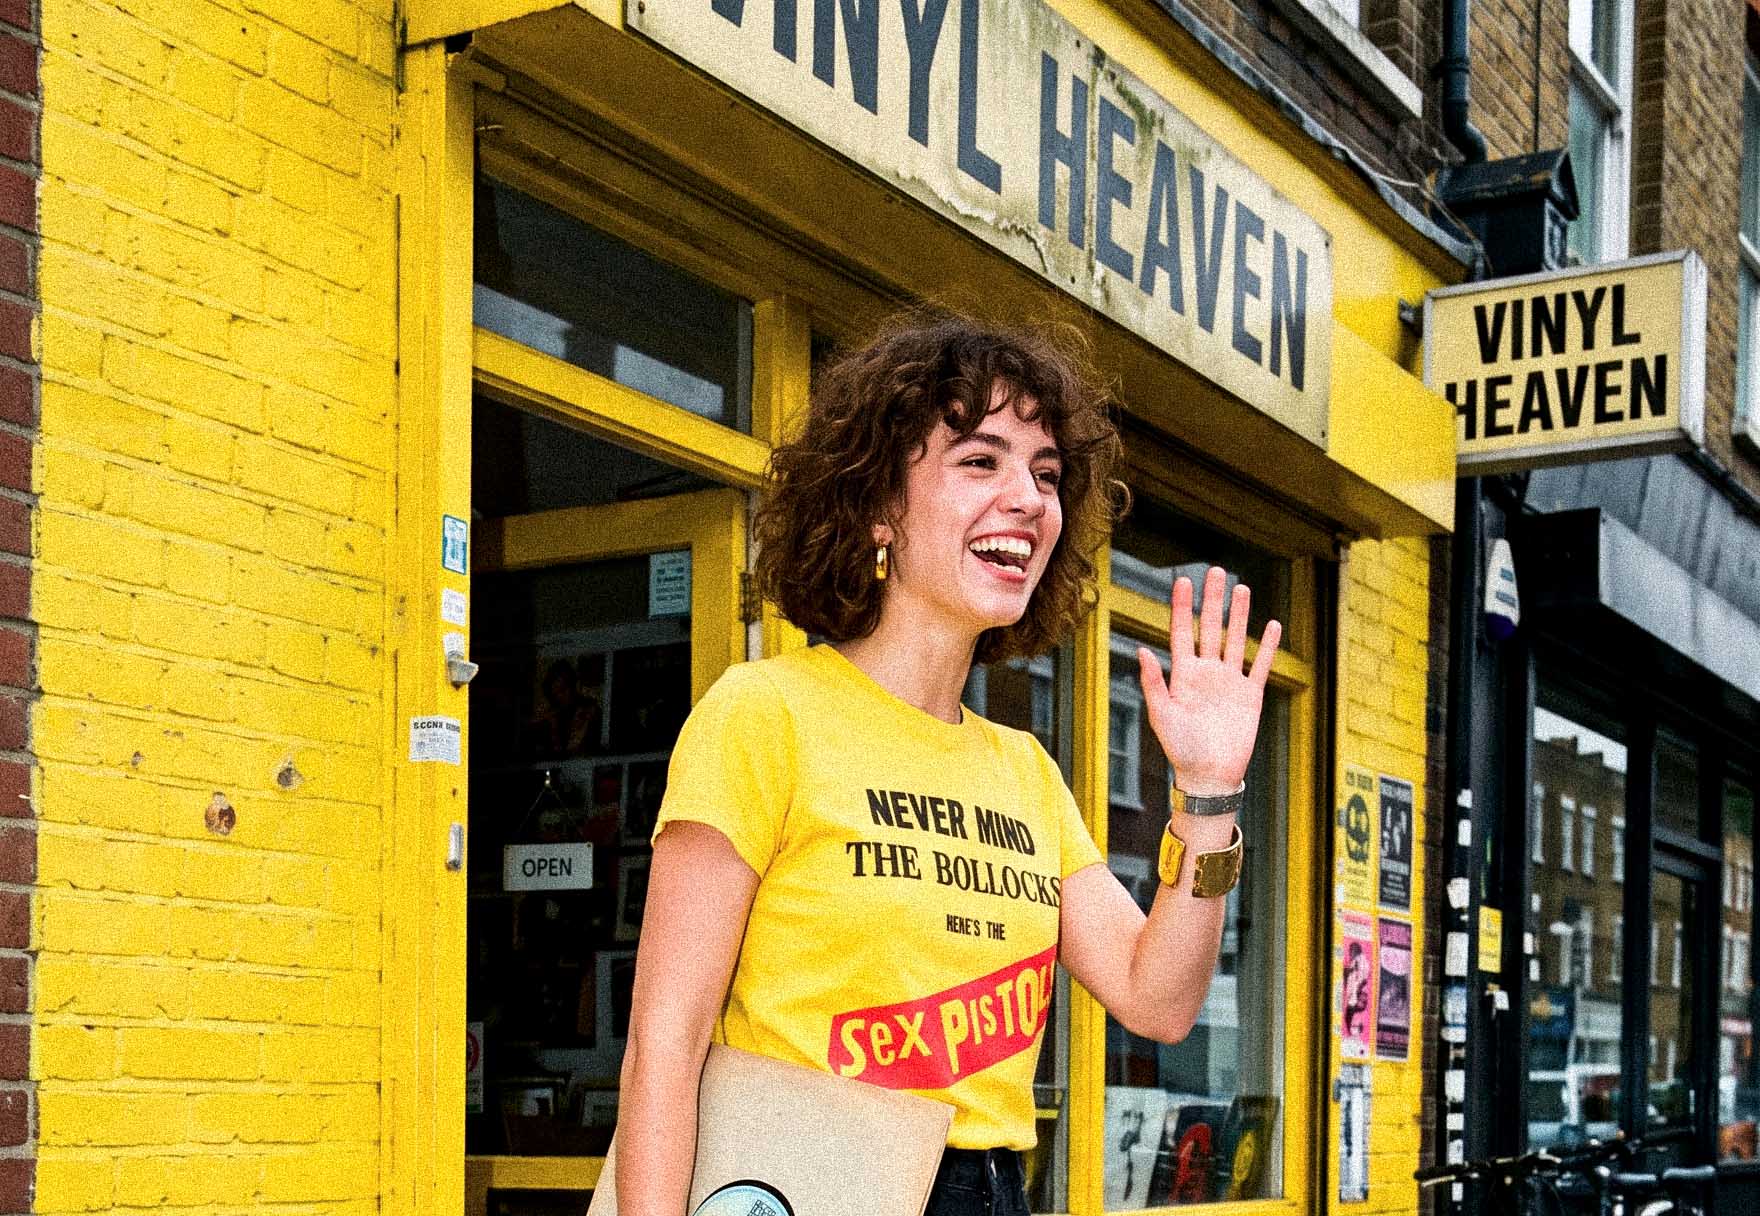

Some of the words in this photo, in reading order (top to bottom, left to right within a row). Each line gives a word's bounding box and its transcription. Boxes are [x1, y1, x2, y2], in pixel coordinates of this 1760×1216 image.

[1039, 49, 1308, 392] HEAVEN
[1474, 283, 1641, 364] VINYL
[1445, 354, 1667, 440] HEAVEN
[865, 788, 968, 840] NEVER
[974, 805, 1035, 856] MIND
[522, 857, 572, 878] OPEN
[846, 841, 922, 880] THE
[932, 850, 1060, 908] BOLLOCKS
[986, 921, 1006, 941] THE
